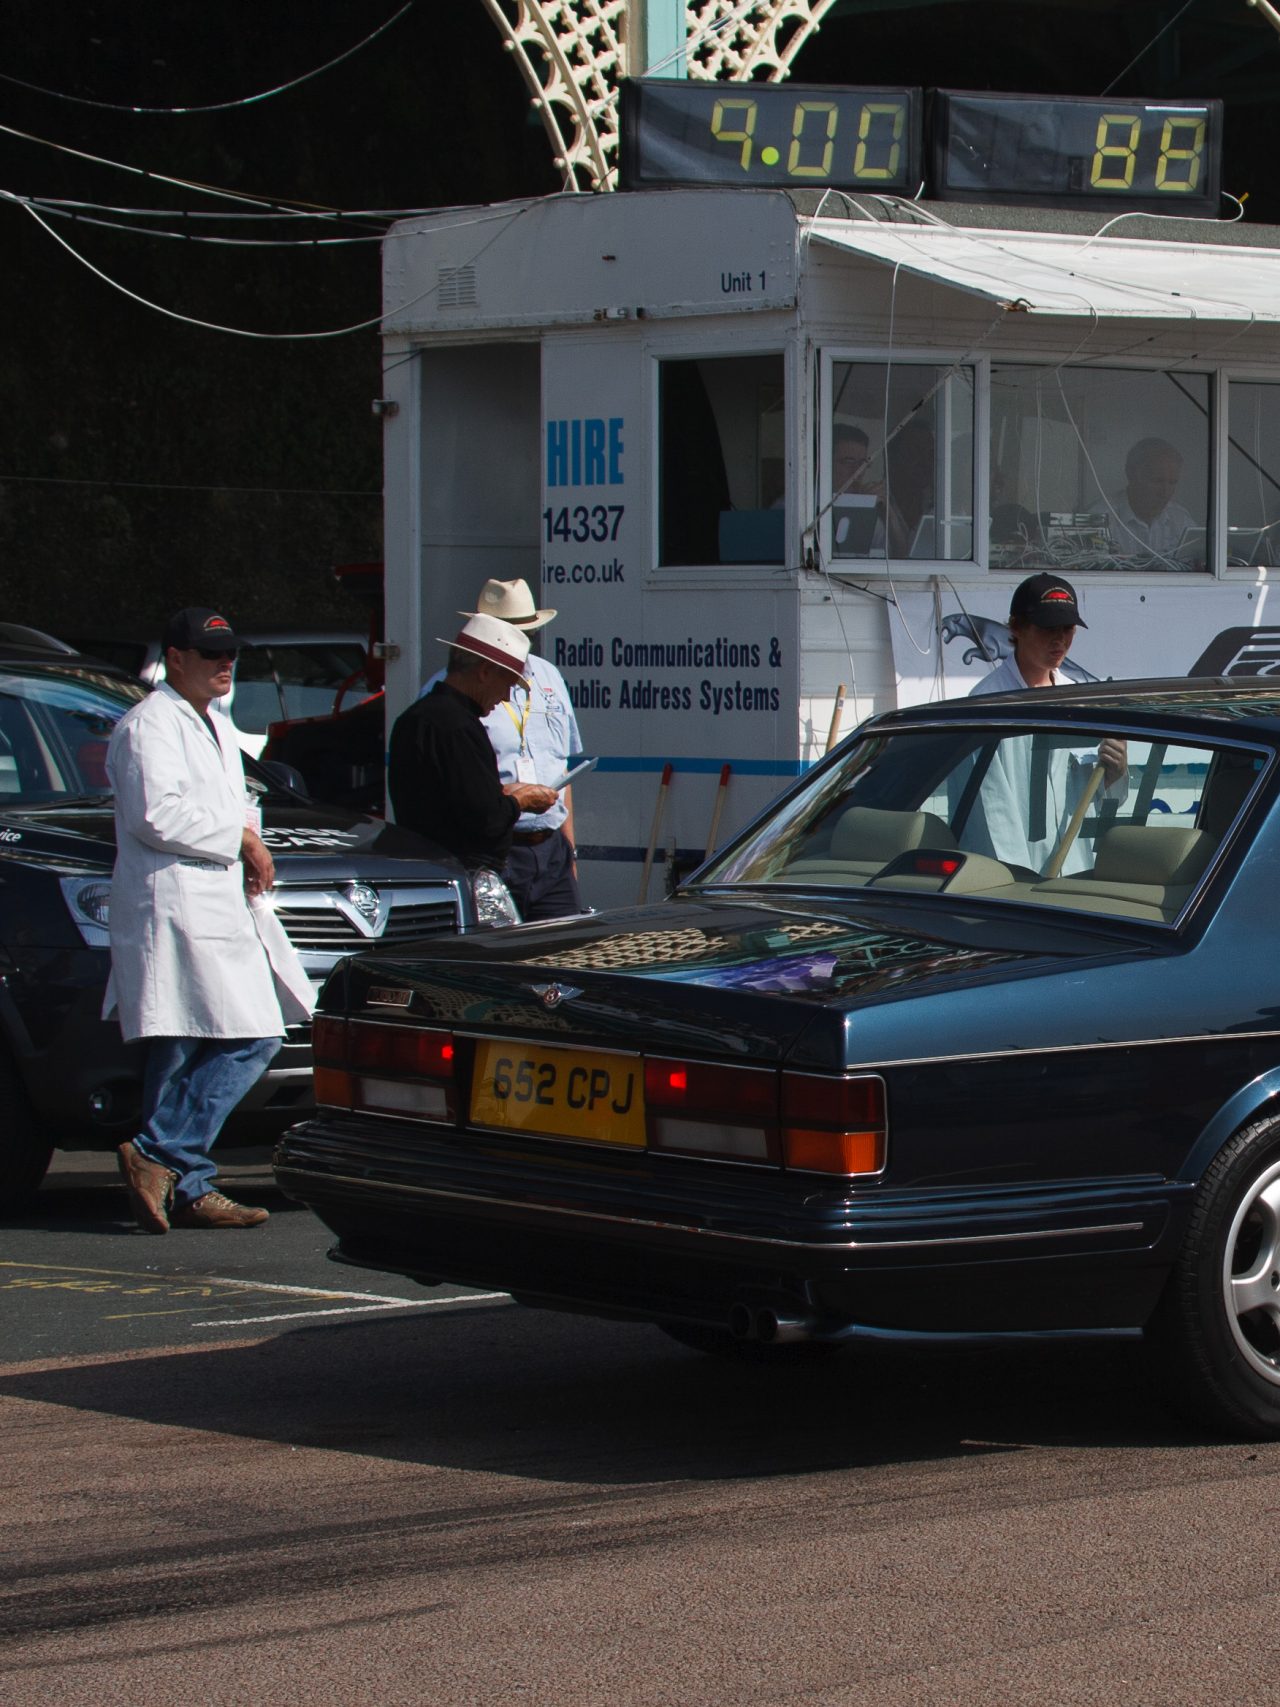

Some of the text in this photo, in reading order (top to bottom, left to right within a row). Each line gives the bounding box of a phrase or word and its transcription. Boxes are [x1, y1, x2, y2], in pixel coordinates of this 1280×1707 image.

[721, 270, 766, 293] Unit 1
[547, 418, 624, 487] HIRE
[543, 505, 625, 543] 14337
[555, 637, 782, 668] Radio Communications &
[563, 679, 611, 709] ublic
[619, 679, 692, 710] Address
[700, 679, 781, 715] Systems
[493, 1057, 635, 1115] 652 CPJ
